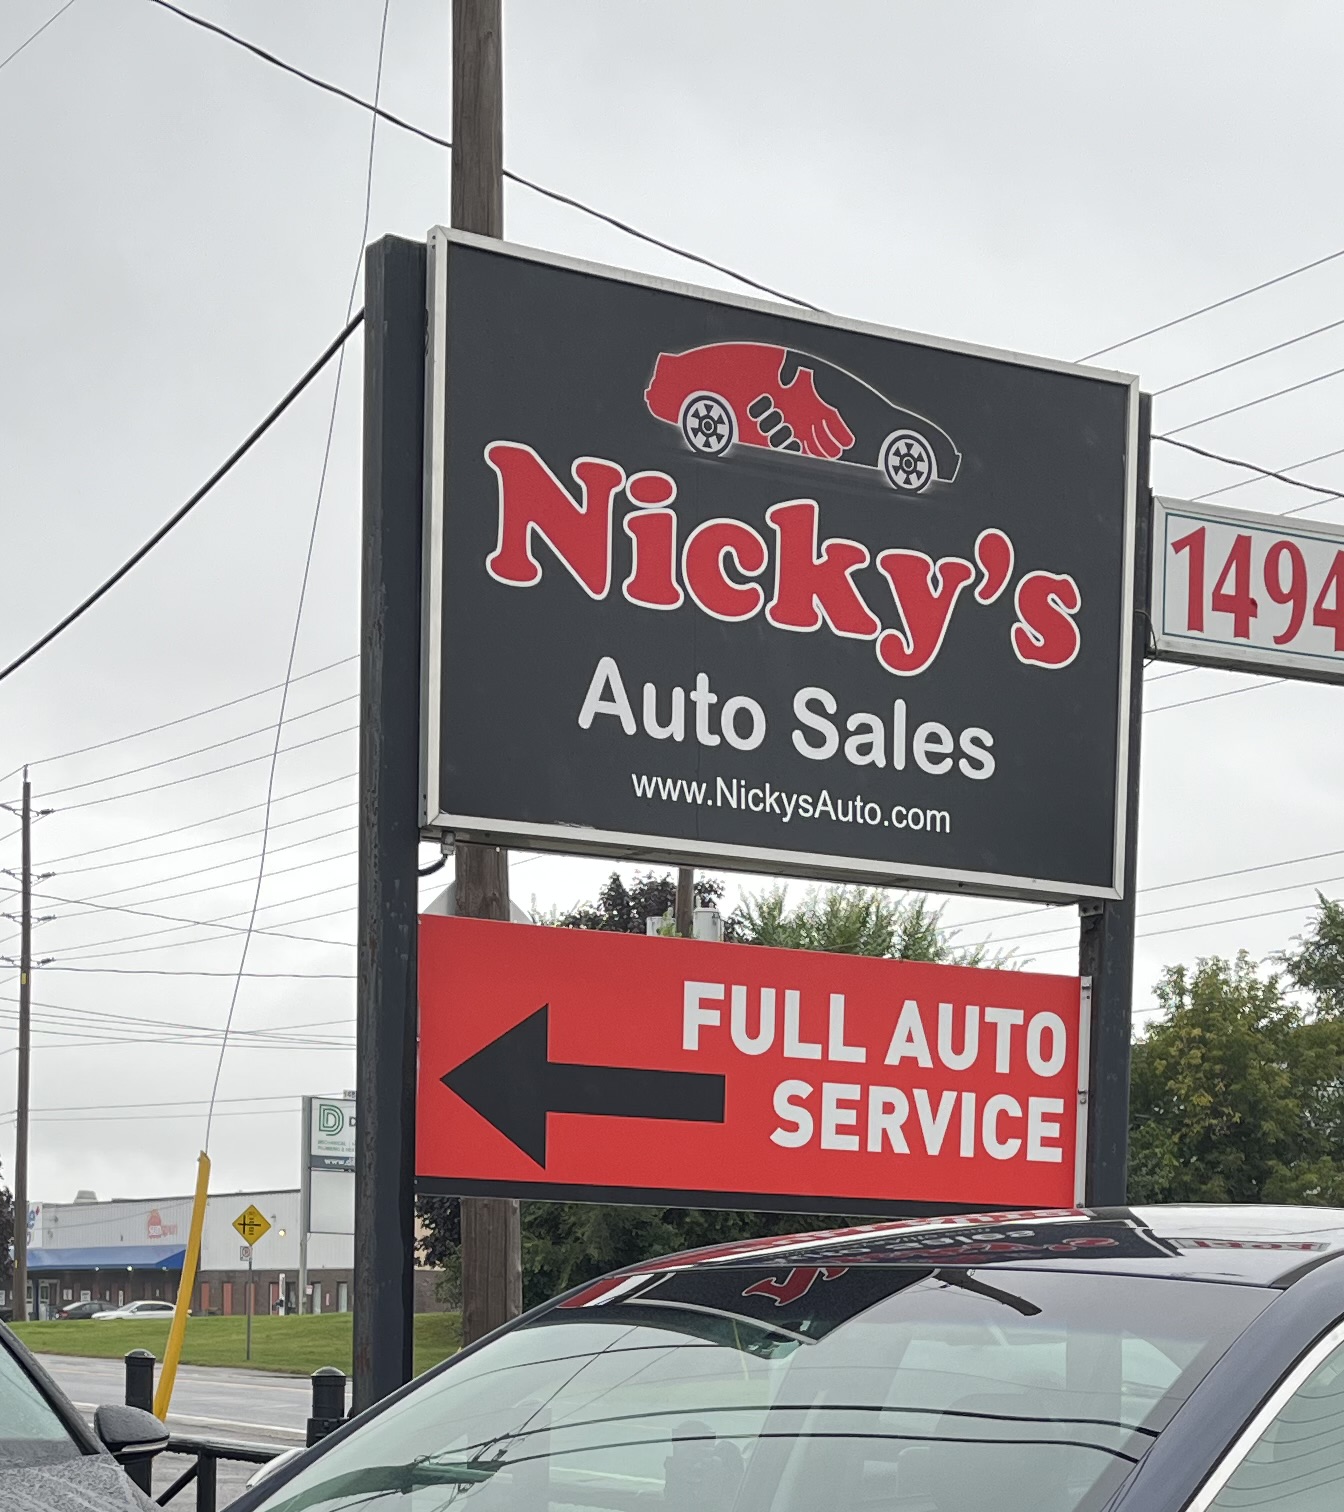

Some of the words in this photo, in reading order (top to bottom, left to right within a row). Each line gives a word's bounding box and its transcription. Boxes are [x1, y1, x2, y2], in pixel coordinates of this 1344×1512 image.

[485, 439, 1082, 676] Nicky's
[578, 655, 767, 752] Auto
[791, 686, 997, 781] Sales
[632, 771, 952, 835] www.NickysAuto.com
[682, 980, 867, 1064] FULL
[885, 1000, 1068, 1078] AUTO
[770, 1078, 1065, 1164] SERVICE
